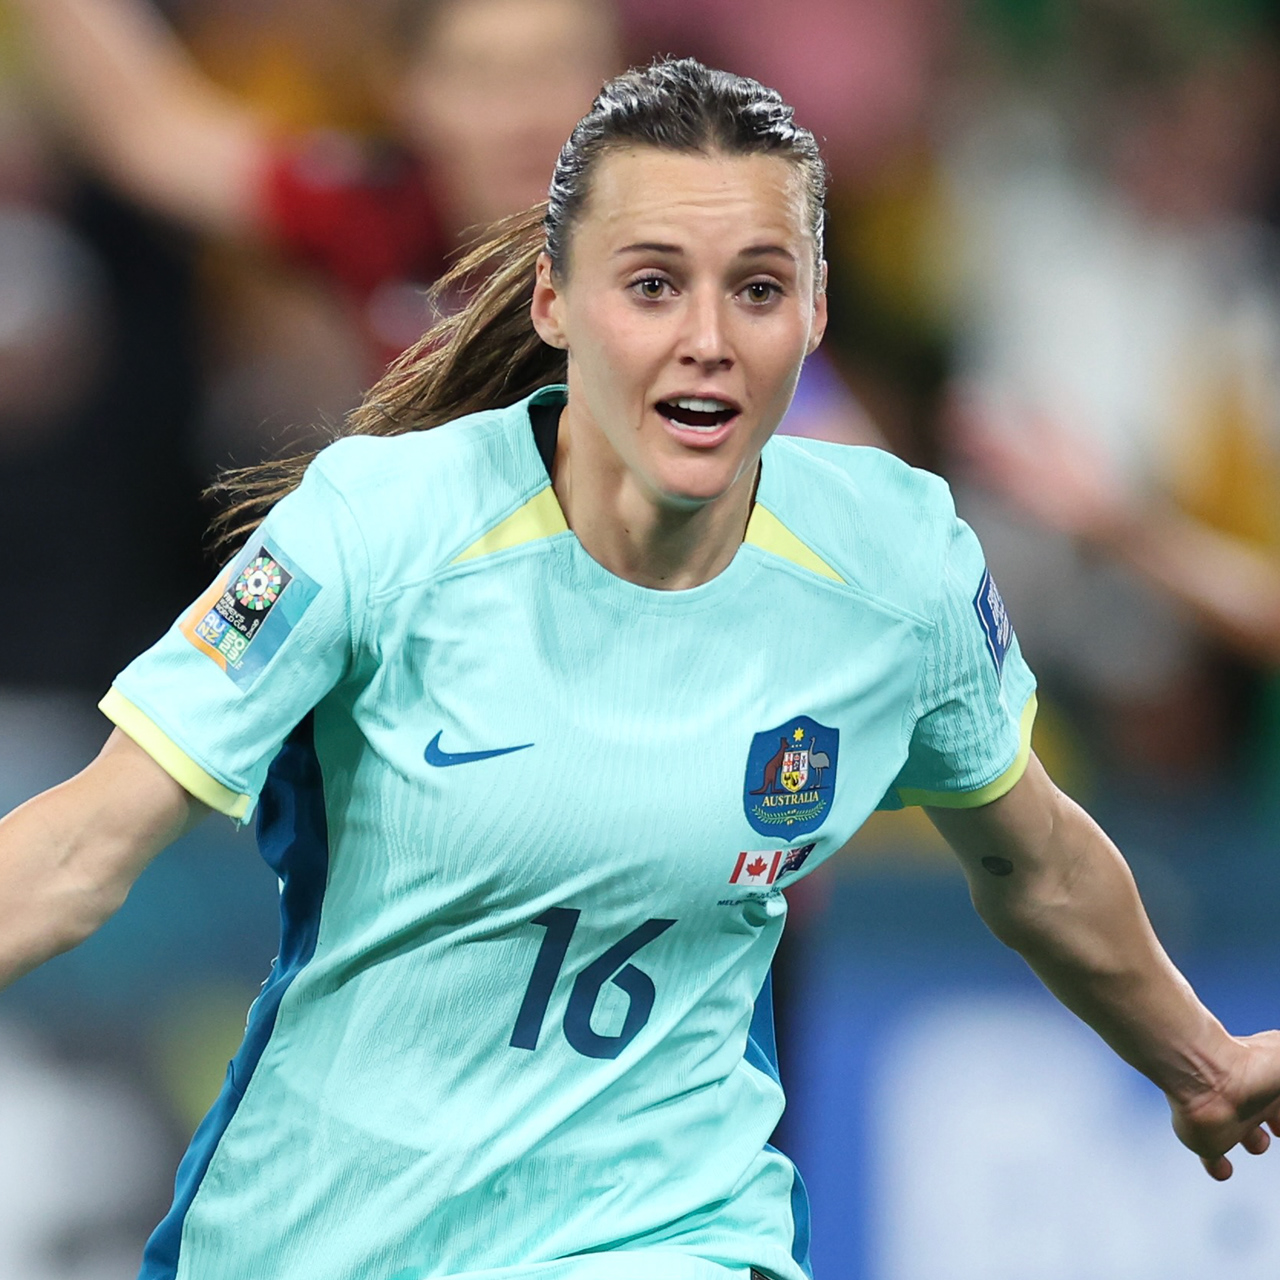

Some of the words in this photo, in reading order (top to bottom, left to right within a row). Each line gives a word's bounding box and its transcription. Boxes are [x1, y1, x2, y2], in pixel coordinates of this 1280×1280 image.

[223, 591, 236, 607] FIFA
[205, 613, 226, 632] AU
[233, 619, 248, 632] CUP
[197, 622, 220, 644] NZ
[762, 791, 819, 807] AUSTRALIA
[508, 906, 679, 1060] 16
